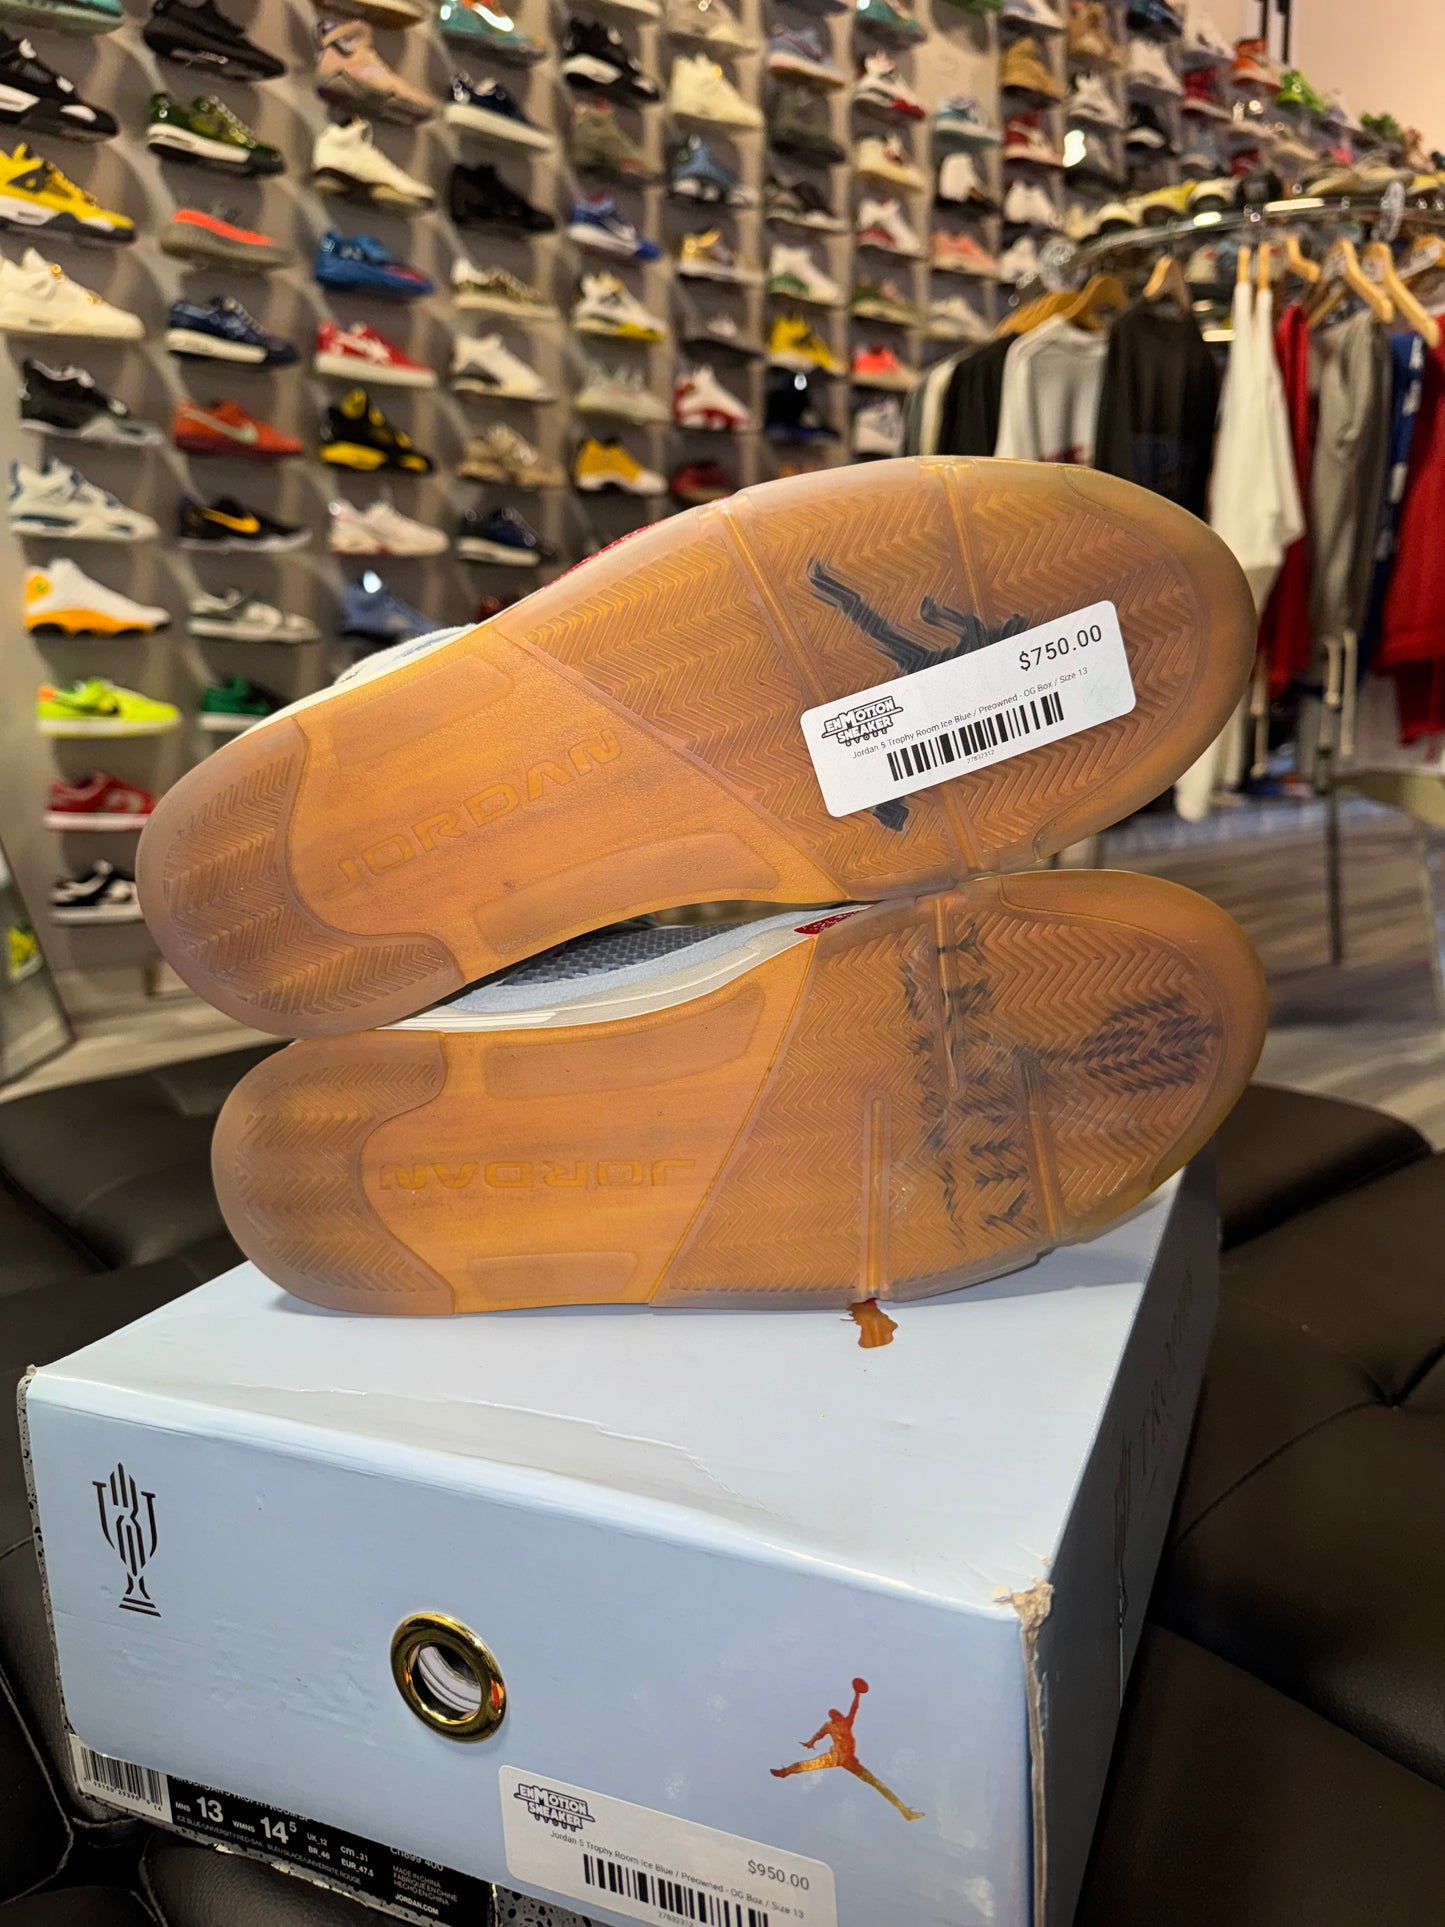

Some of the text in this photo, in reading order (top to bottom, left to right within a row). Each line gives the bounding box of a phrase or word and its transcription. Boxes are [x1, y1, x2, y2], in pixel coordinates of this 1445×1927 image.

[1019, 624, 1102, 672] $750.00
[852, 745, 879, 759] Jordan
[880, 741, 886, 749] 5
[888, 733, 915, 747] Trophy
[916, 723, 940, 737] Room
[941, 718, 953, 728] Ice
[954, 710, 972, 723] Blue
[978, 694, 1018, 715] Preowned
[1023, 687, 1036, 698] OG
[1037, 681, 1053, 693] Box
[1059, 672, 1077, 684] Size
[1078, 667, 1088, 677] 13
[837, 716, 893, 743] SNEAKER
[966, 749, 995, 764] 27832312
[326, 728, 624, 899] JORDAN
[379, 1159, 695, 1191] JORDAN
[175, 1801, 190, 1812] MNS
[197, 1796, 224, 1823] 13
[232, 1820, 256, 1833] WMNS
[527, 1801, 583, 1829] SNEAKER
[393, 1865, 441, 1889] MADE IN CHINA
[550, 1830, 577, 1845] Jordan
[579, 1838, 584, 1847] 5
[586, 1841, 613, 1858] Trophy
[614, 1850, 639, 1865] Room
[640, 1858, 653, 1868] Ice
[654, 1862, 673, 1876] Blue
[681, 1872, 724, 1893] Preowned
[731, 1888, 744, 1899] OG
[746, 1893, 763, 1906] Box
[771, 1901, 790, 1914] Size
[793, 1908, 805, 1919] 13
[747, 1858, 810, 1891] $950.00
[393, 1879, 418, 1894] HECHO
[428, 1892, 450, 1906] CHINA
[394, 1893, 439, 1916] JORDAN.COM
